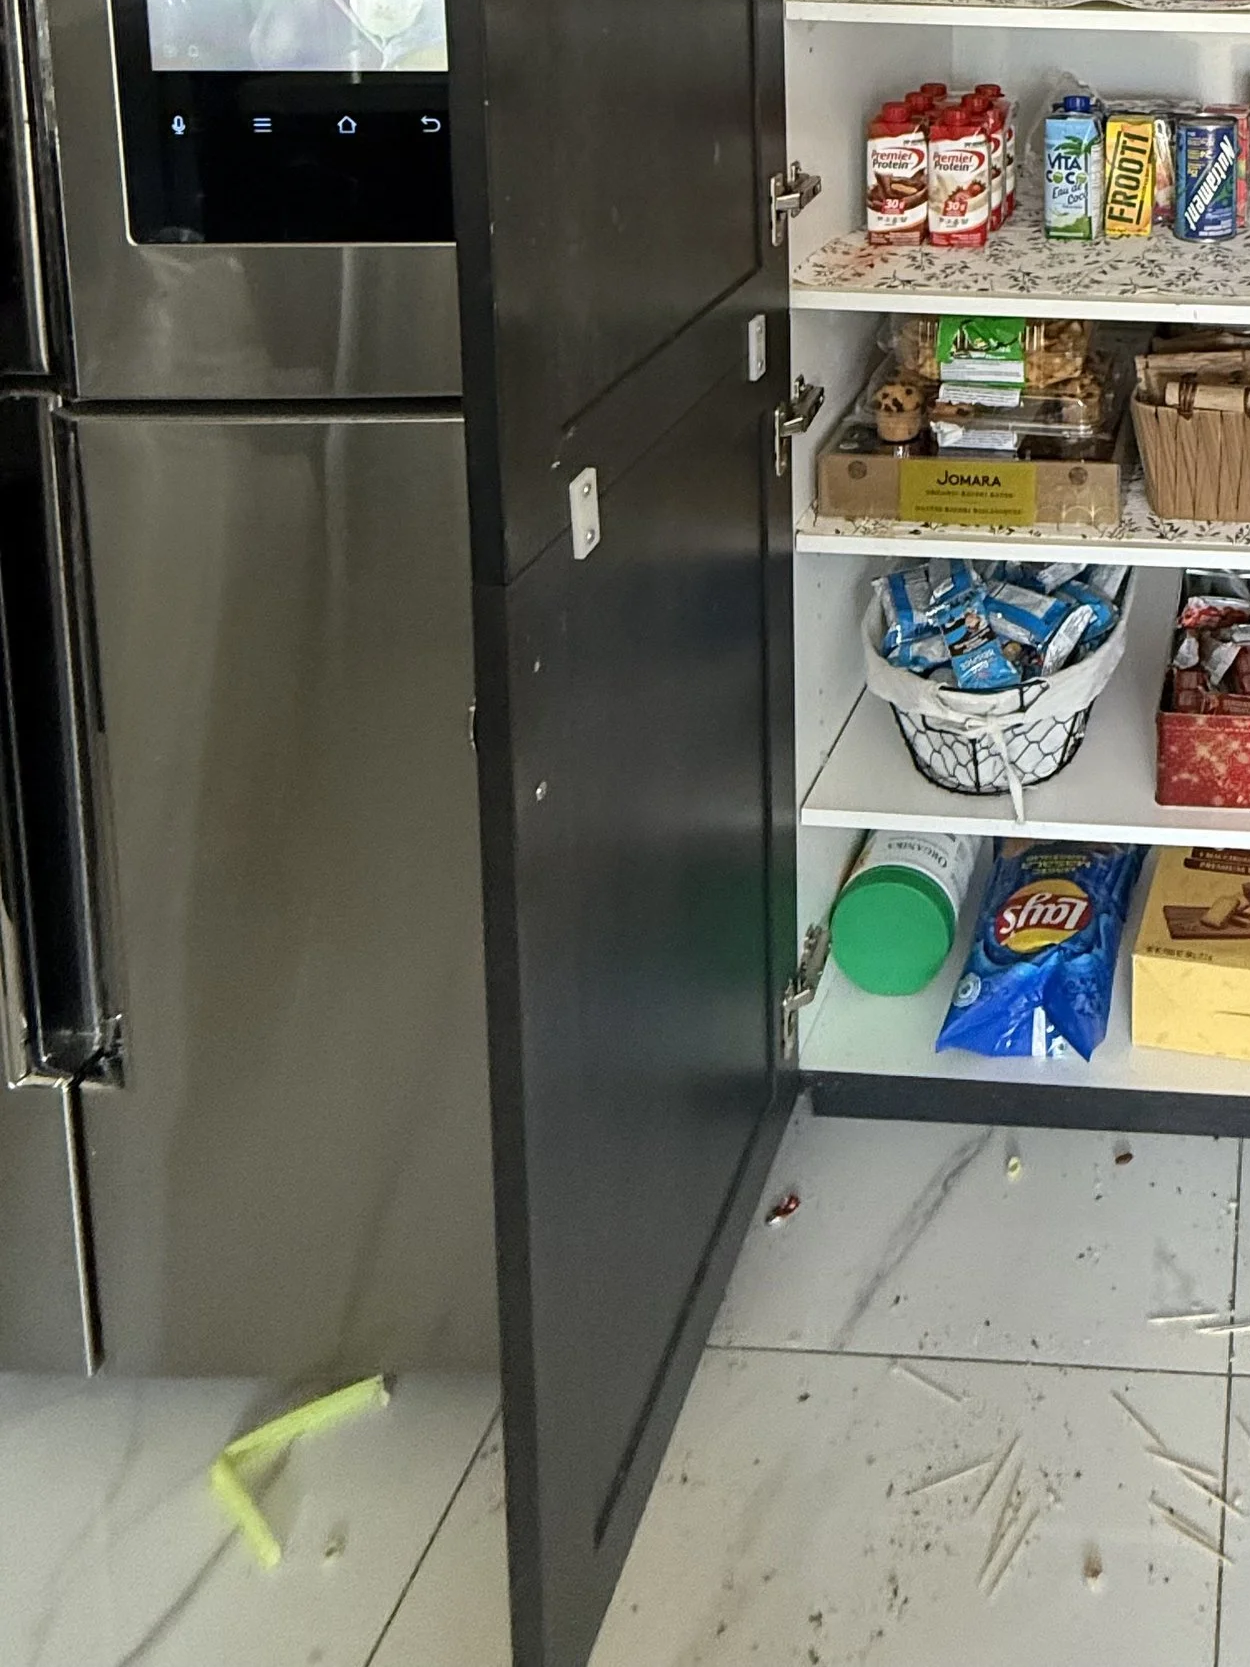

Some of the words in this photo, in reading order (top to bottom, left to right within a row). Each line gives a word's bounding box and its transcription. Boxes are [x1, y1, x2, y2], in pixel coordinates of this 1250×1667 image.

[871, 149, 912, 162] Premier
[933, 151, 974, 163] Premier
[1047, 152, 1082, 171] VITA
[872, 159, 909, 171] Protein
[934, 161, 970, 172] Protein
[1107, 131, 1149, 224] FROOTI
[1184, 134, 1236, 232] Nutrament
